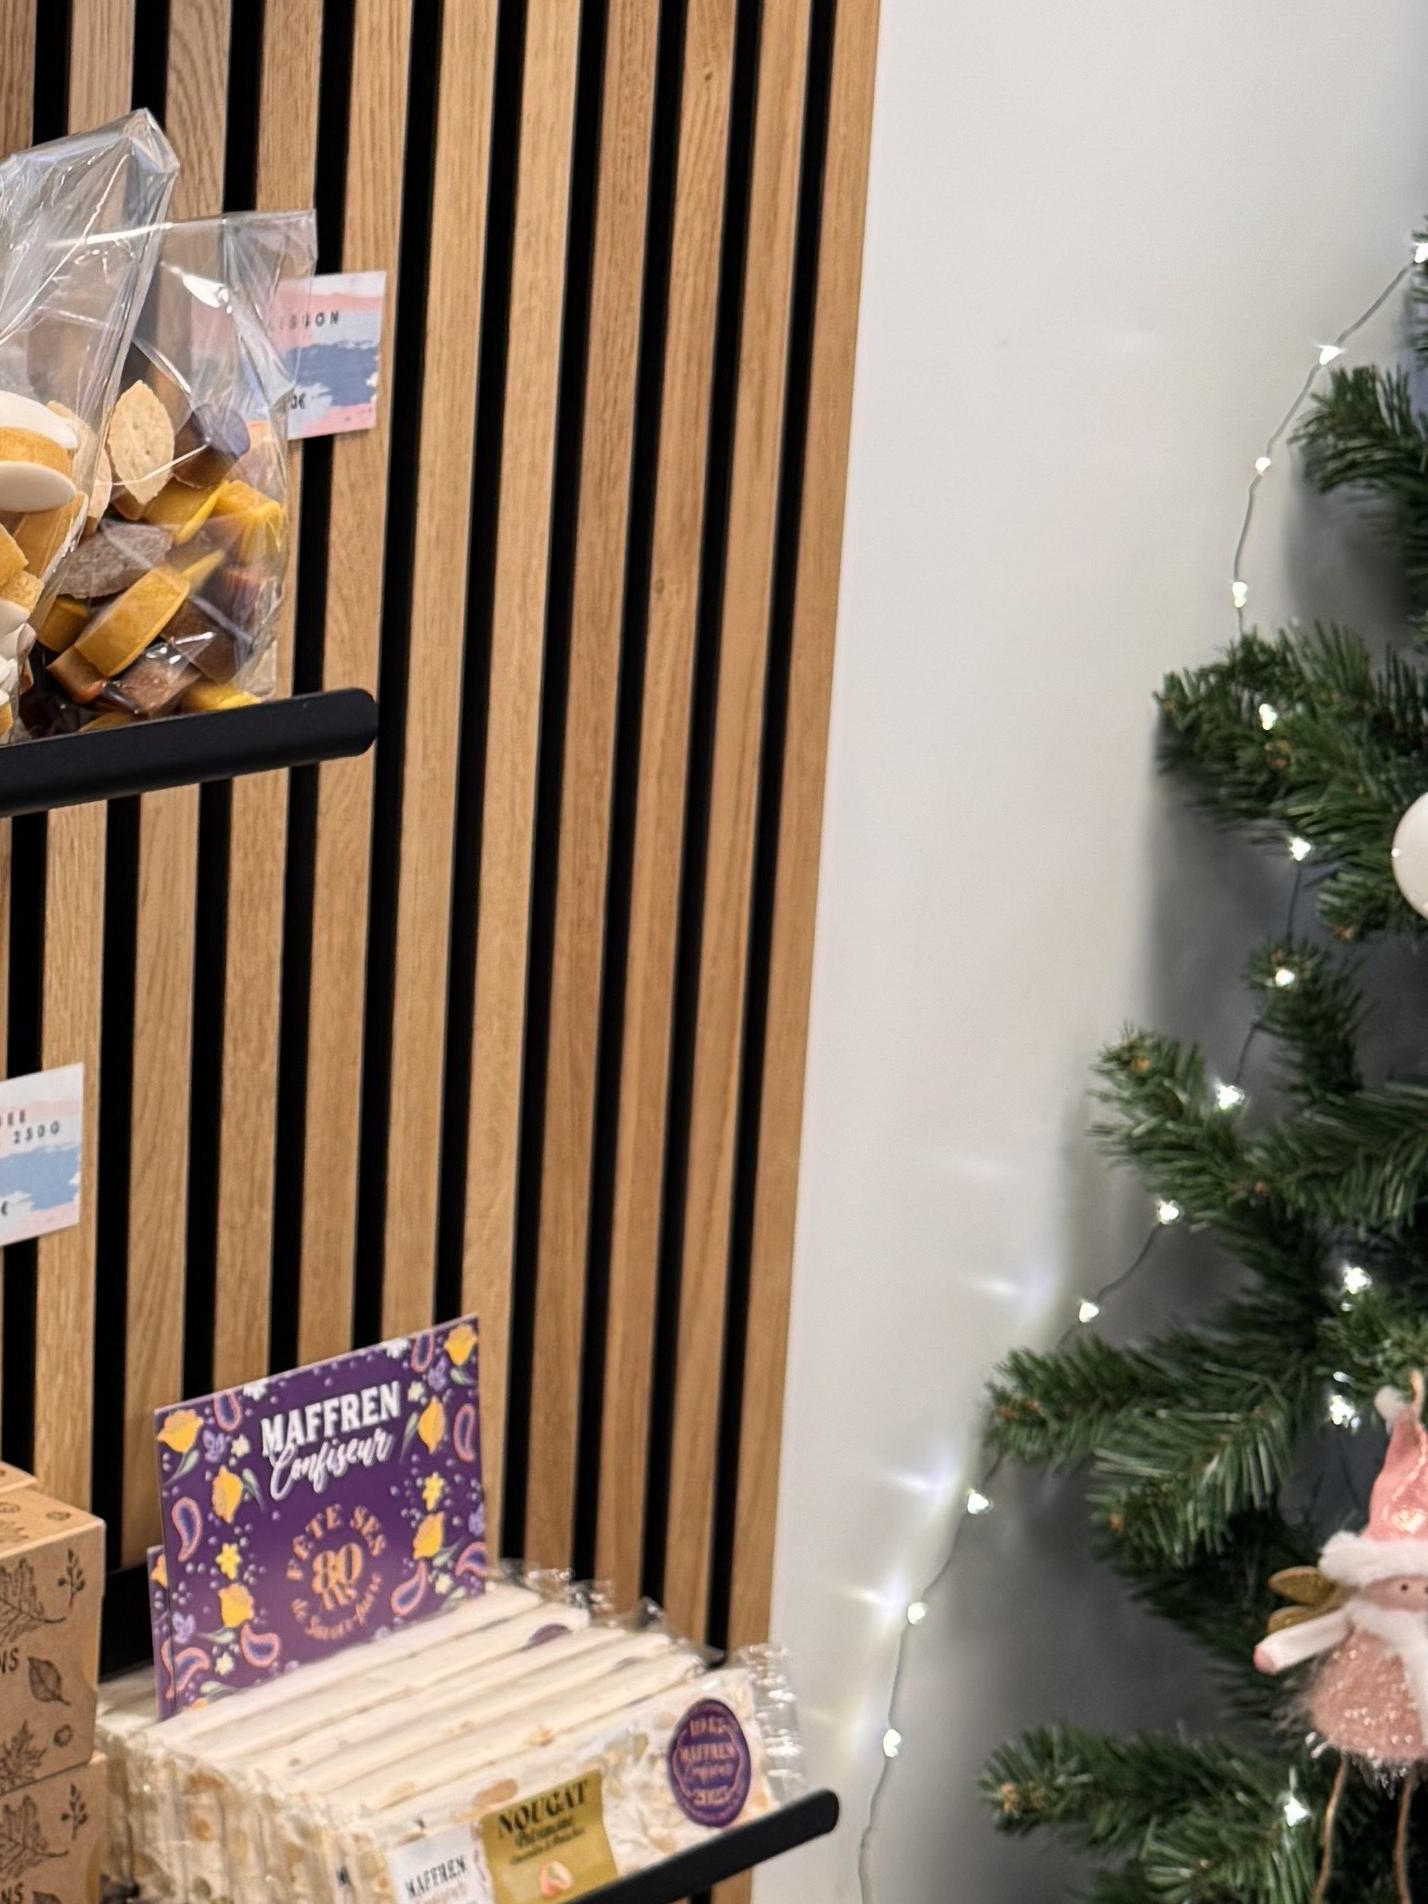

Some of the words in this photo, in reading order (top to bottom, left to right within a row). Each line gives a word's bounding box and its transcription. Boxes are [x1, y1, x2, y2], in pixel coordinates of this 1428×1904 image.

[13, 1120, 61, 1145] 250G
[261, 1380, 401, 1458] MAFFREN
[269, 1427, 395, 1501] Confiseur
[312, 1542, 363, 1594] 80
[498, 1780, 588, 1840] NOUGAT
